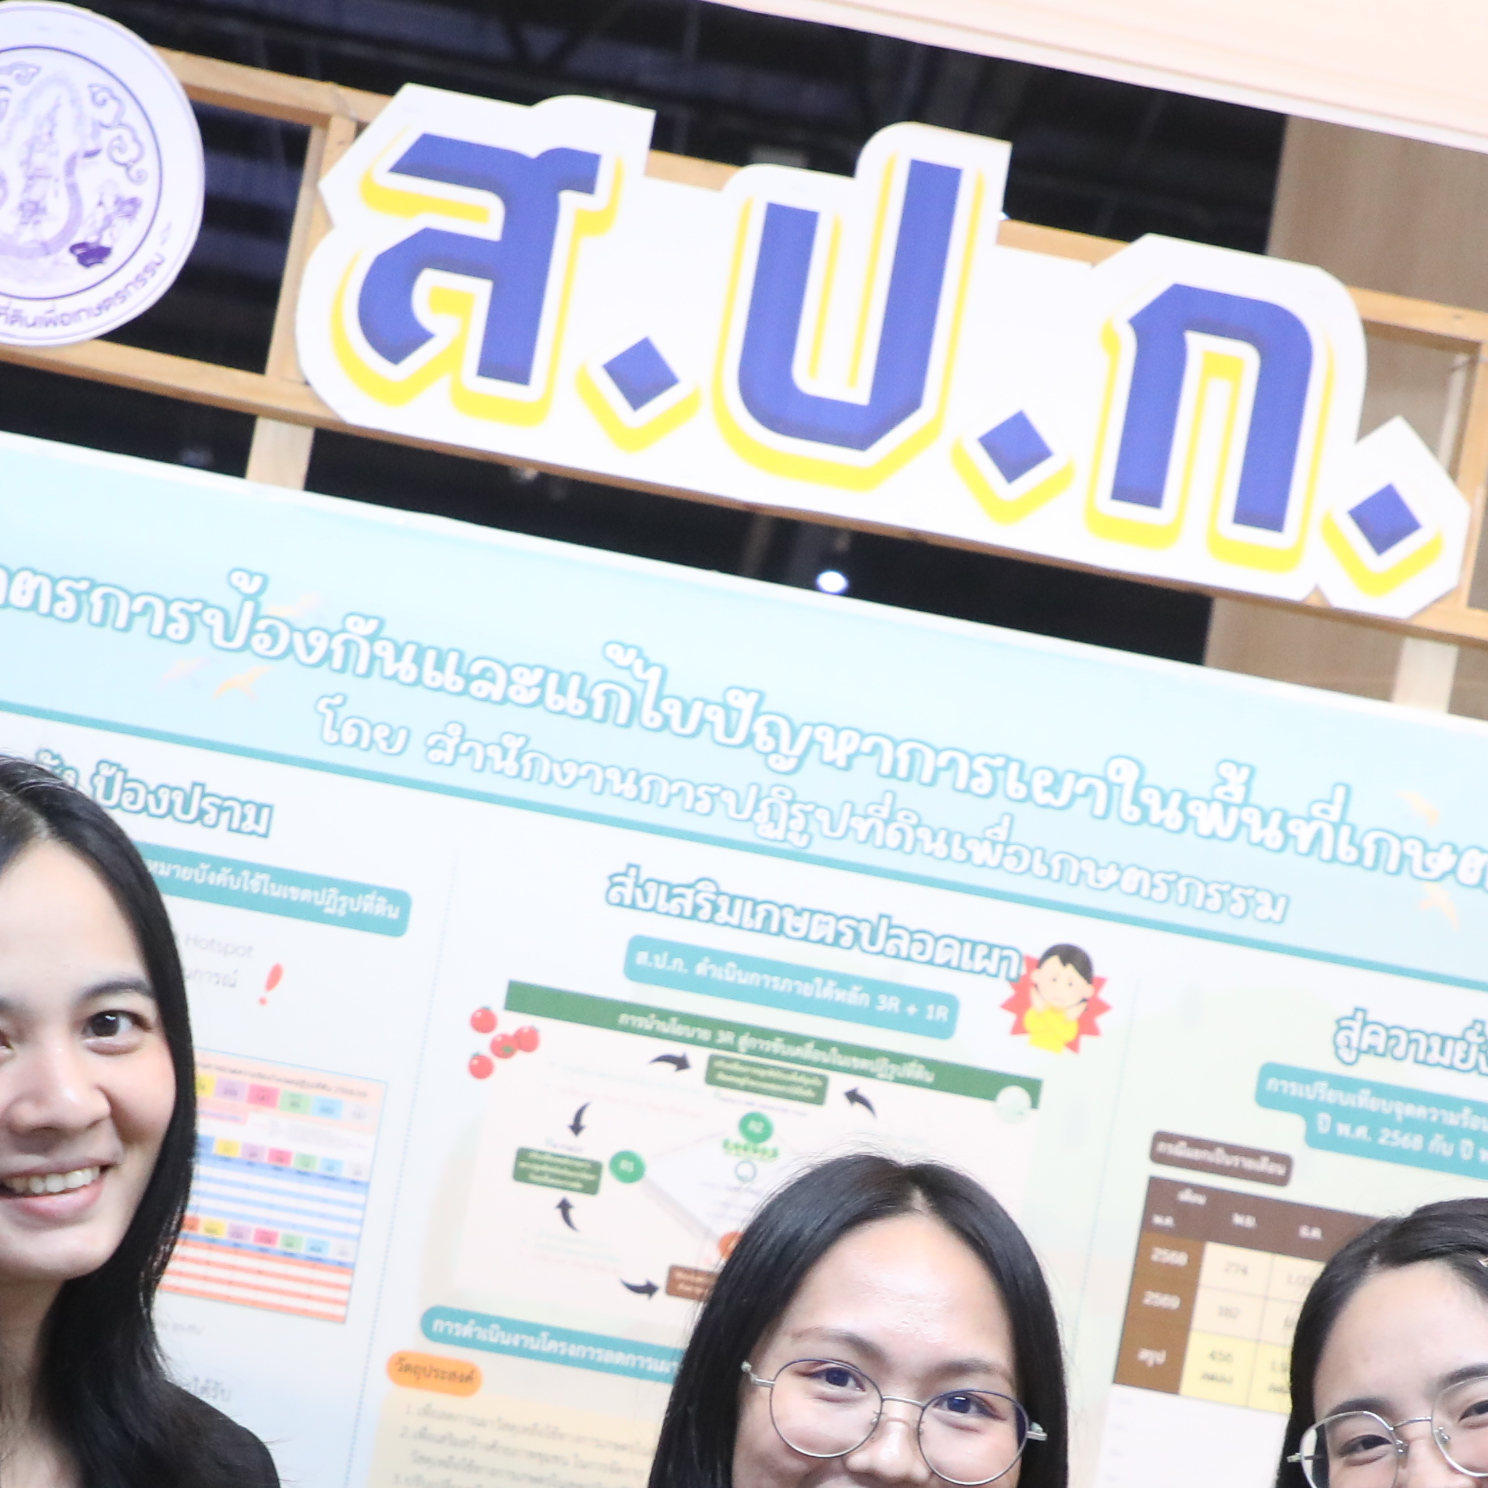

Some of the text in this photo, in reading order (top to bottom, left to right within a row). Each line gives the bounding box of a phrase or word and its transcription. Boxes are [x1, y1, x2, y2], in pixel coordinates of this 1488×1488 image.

[350, 128, 1428, 565] ส.ป.ก.
[93, 762, 274, 838] ป้องปราม
[314, 696, 1291, 925] โดย สำนักงานการปฏิรูปที่ดินเพื่อเกษตรกรรม
[605, 863, 1023, 983] ส่งเสริมเกษตรปลอดเผา
[634, 949, 690, 976] ส.ป.ก.
[694, 956, 872, 1009] ดำเนินการภายใต้หลัก
[875, 993, 902, 1014] 3R
[925, 1003, 949, 1023] 1R
[1377, 1128, 1426, 1153] 2568
